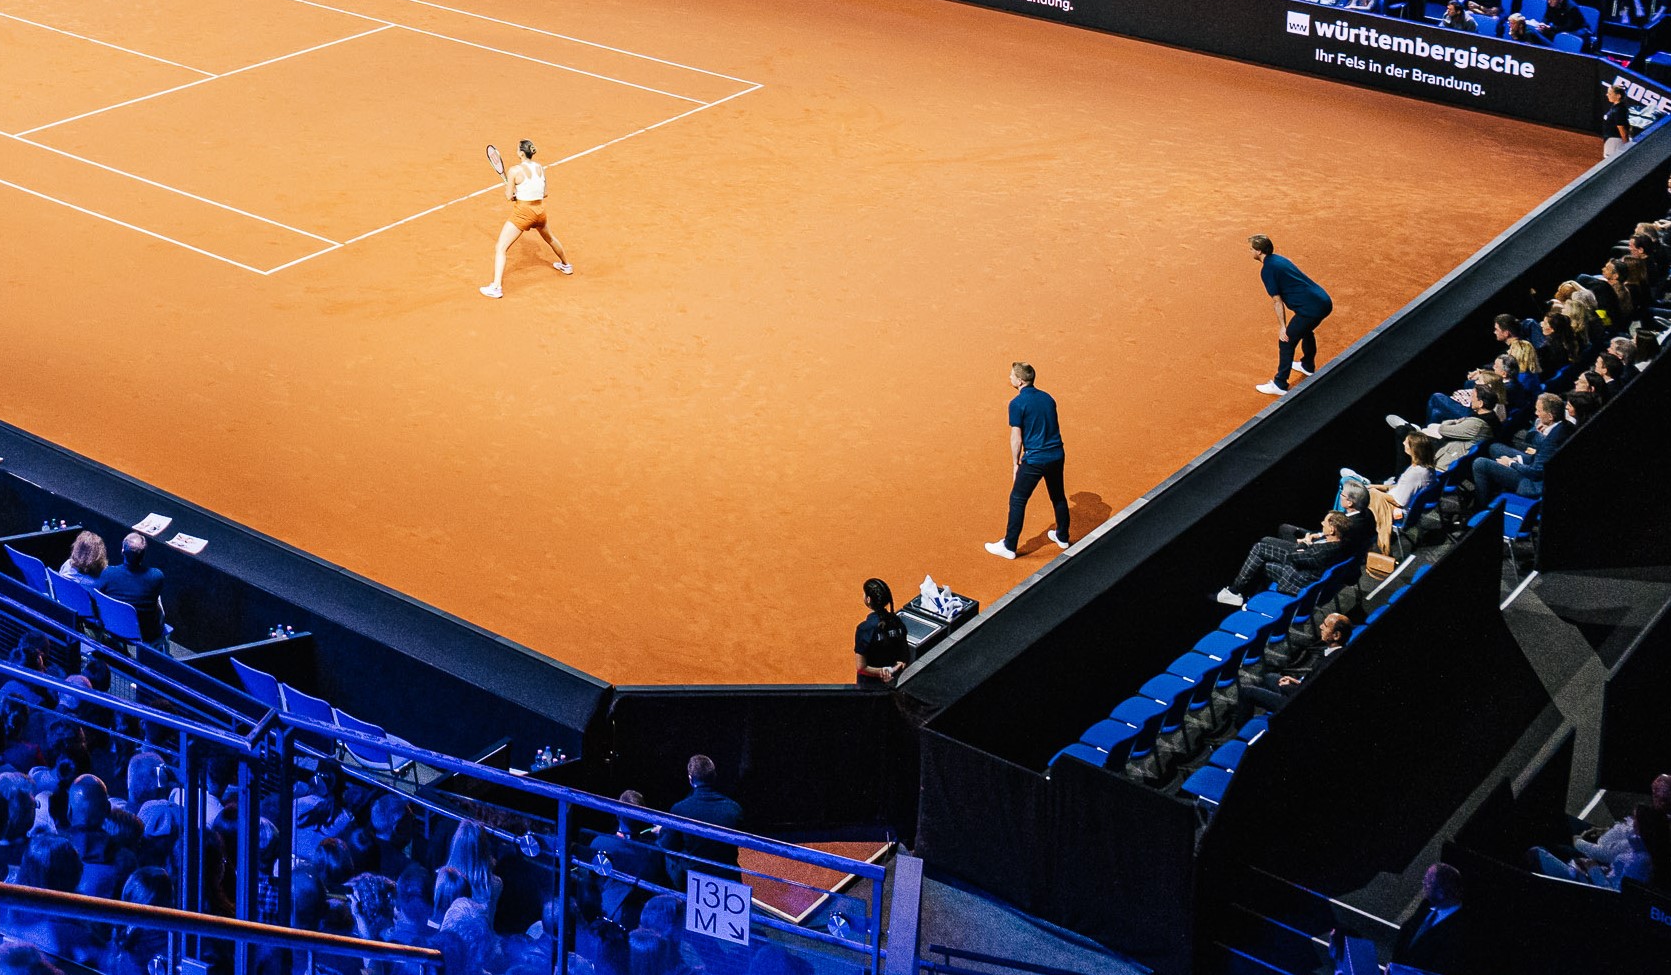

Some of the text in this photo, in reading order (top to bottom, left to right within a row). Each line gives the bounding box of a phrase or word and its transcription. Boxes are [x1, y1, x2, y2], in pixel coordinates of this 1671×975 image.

[1315, 19, 1535, 79] württembergische
[1315, 48, 1486, 96] Ihr Fels in der Brandung.
[692, 877, 746, 914] 13b
[694, 908, 718, 933] M
